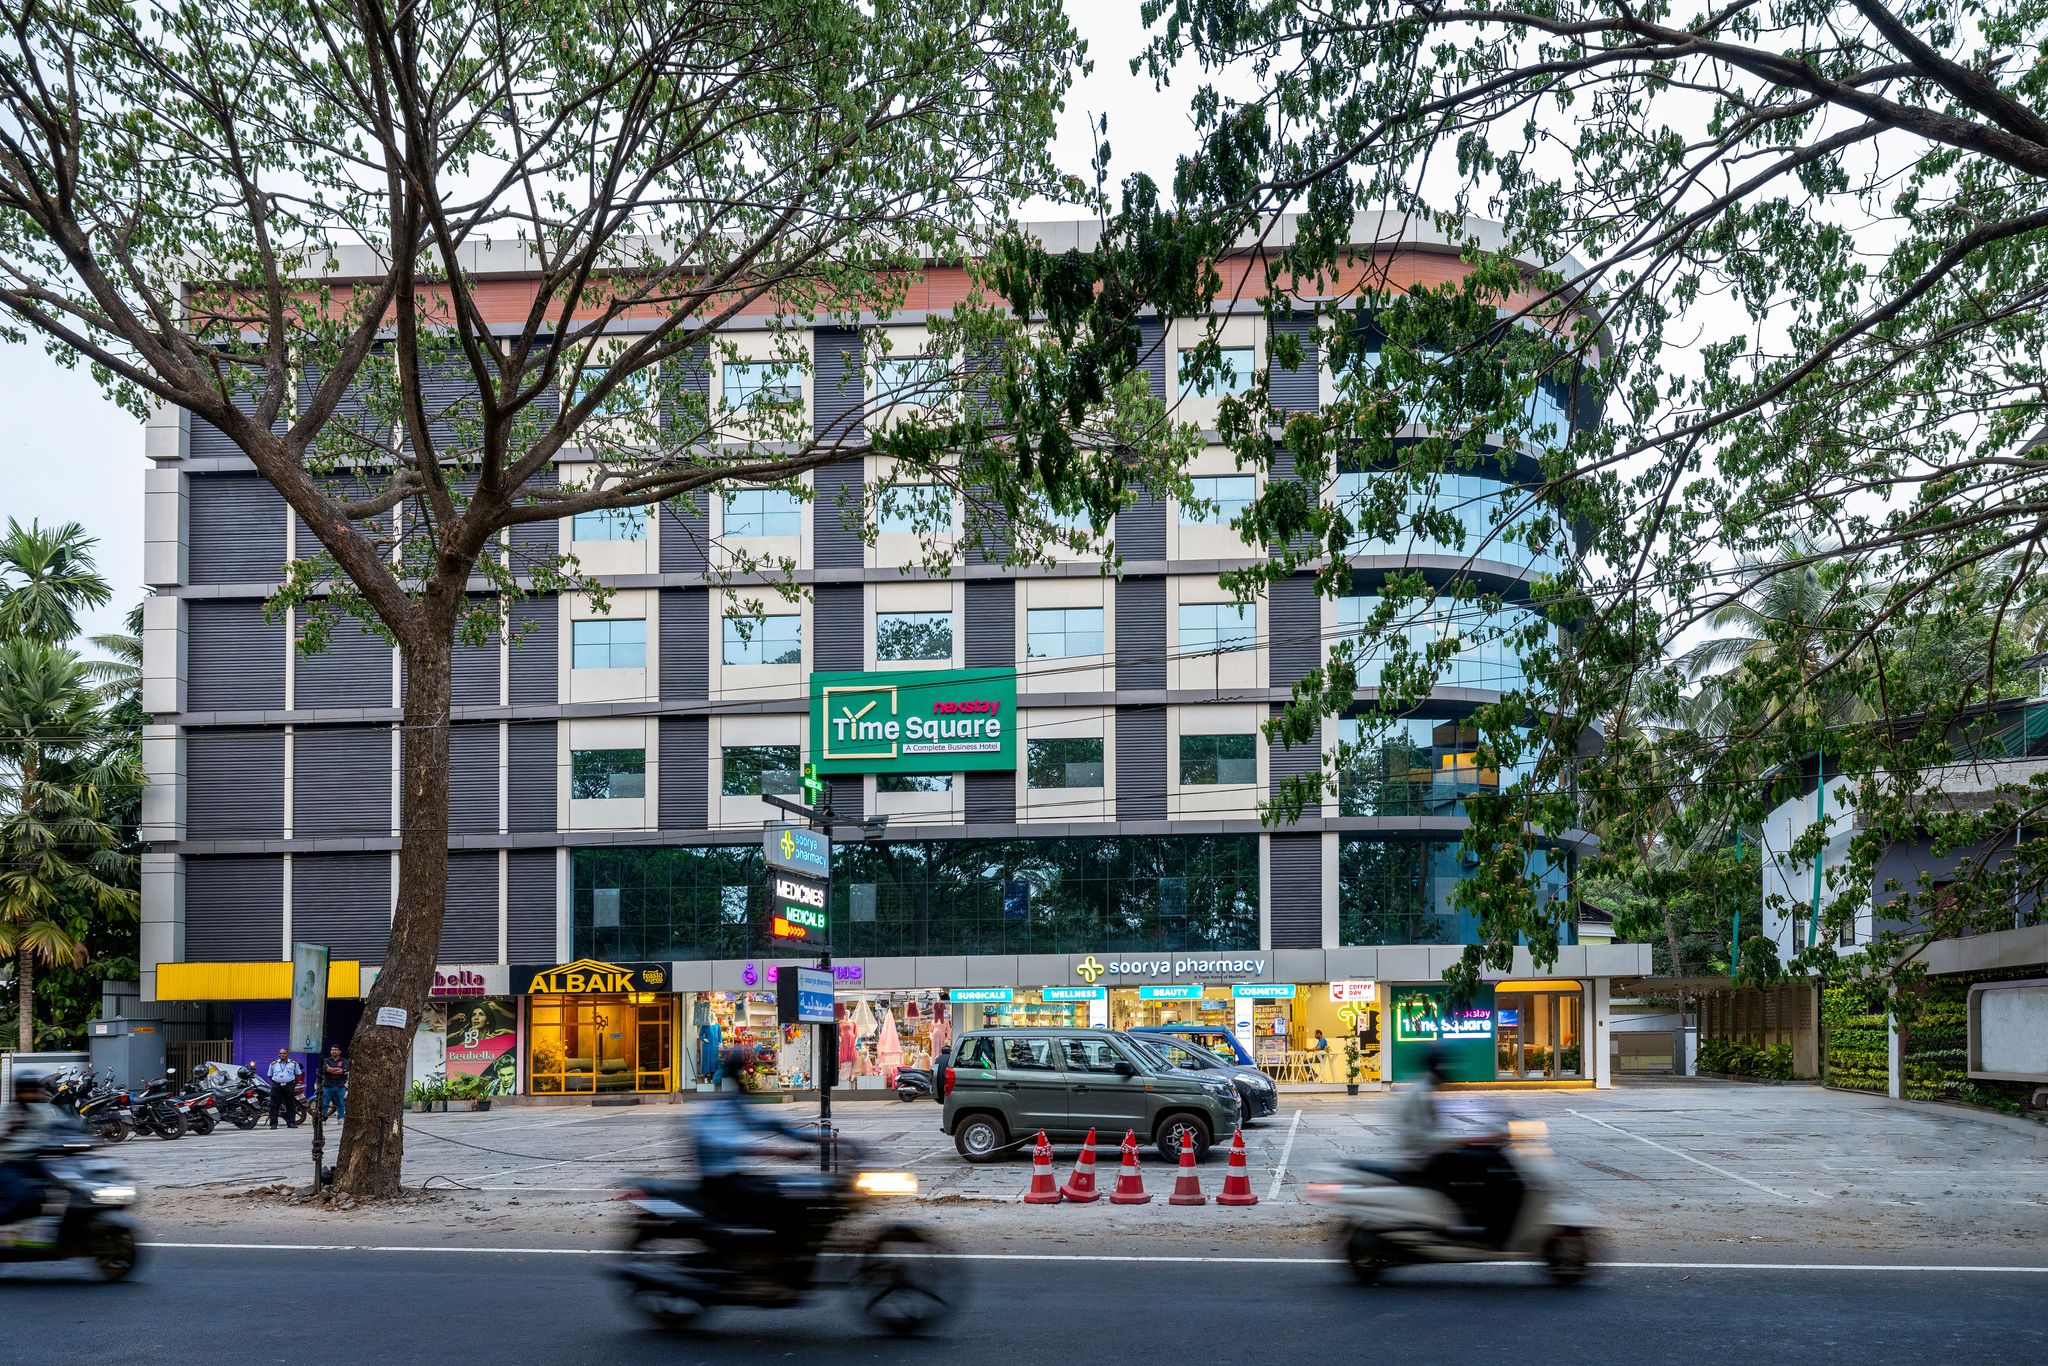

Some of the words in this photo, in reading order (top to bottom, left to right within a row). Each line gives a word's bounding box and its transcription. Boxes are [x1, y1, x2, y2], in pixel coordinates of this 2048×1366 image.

[933, 698, 1000, 716] nexstay
[832, 716, 900, 741] Time
[905, 716, 1001, 744] Square
[905, 744, 912, 752] A
[913, 744, 946, 752] Complete
[947, 742, 978, 751] Business
[979, 742, 998, 750] Hotel
[795, 834, 818, 851] soorya
[795, 847, 828, 869] pharmacy
[776, 879, 824, 908] MEDICINES
[786, 906, 818, 927] MEDICAL
[1109, 960, 1171, 977] soorya
[1175, 957, 1265, 977] pharmacy
[527, 973, 636, 994] ALBAIK
[1153, 988, 1189, 997] BEAUTY
[1238, 987, 1289, 996] COSMETICS
[957, 991, 1006, 1000] SURGICALS
[1051, 989, 1097, 999] WELLNESS
[800, 992, 833, 1016] صيدلية
[1440, 1018, 1492, 1034] Square
